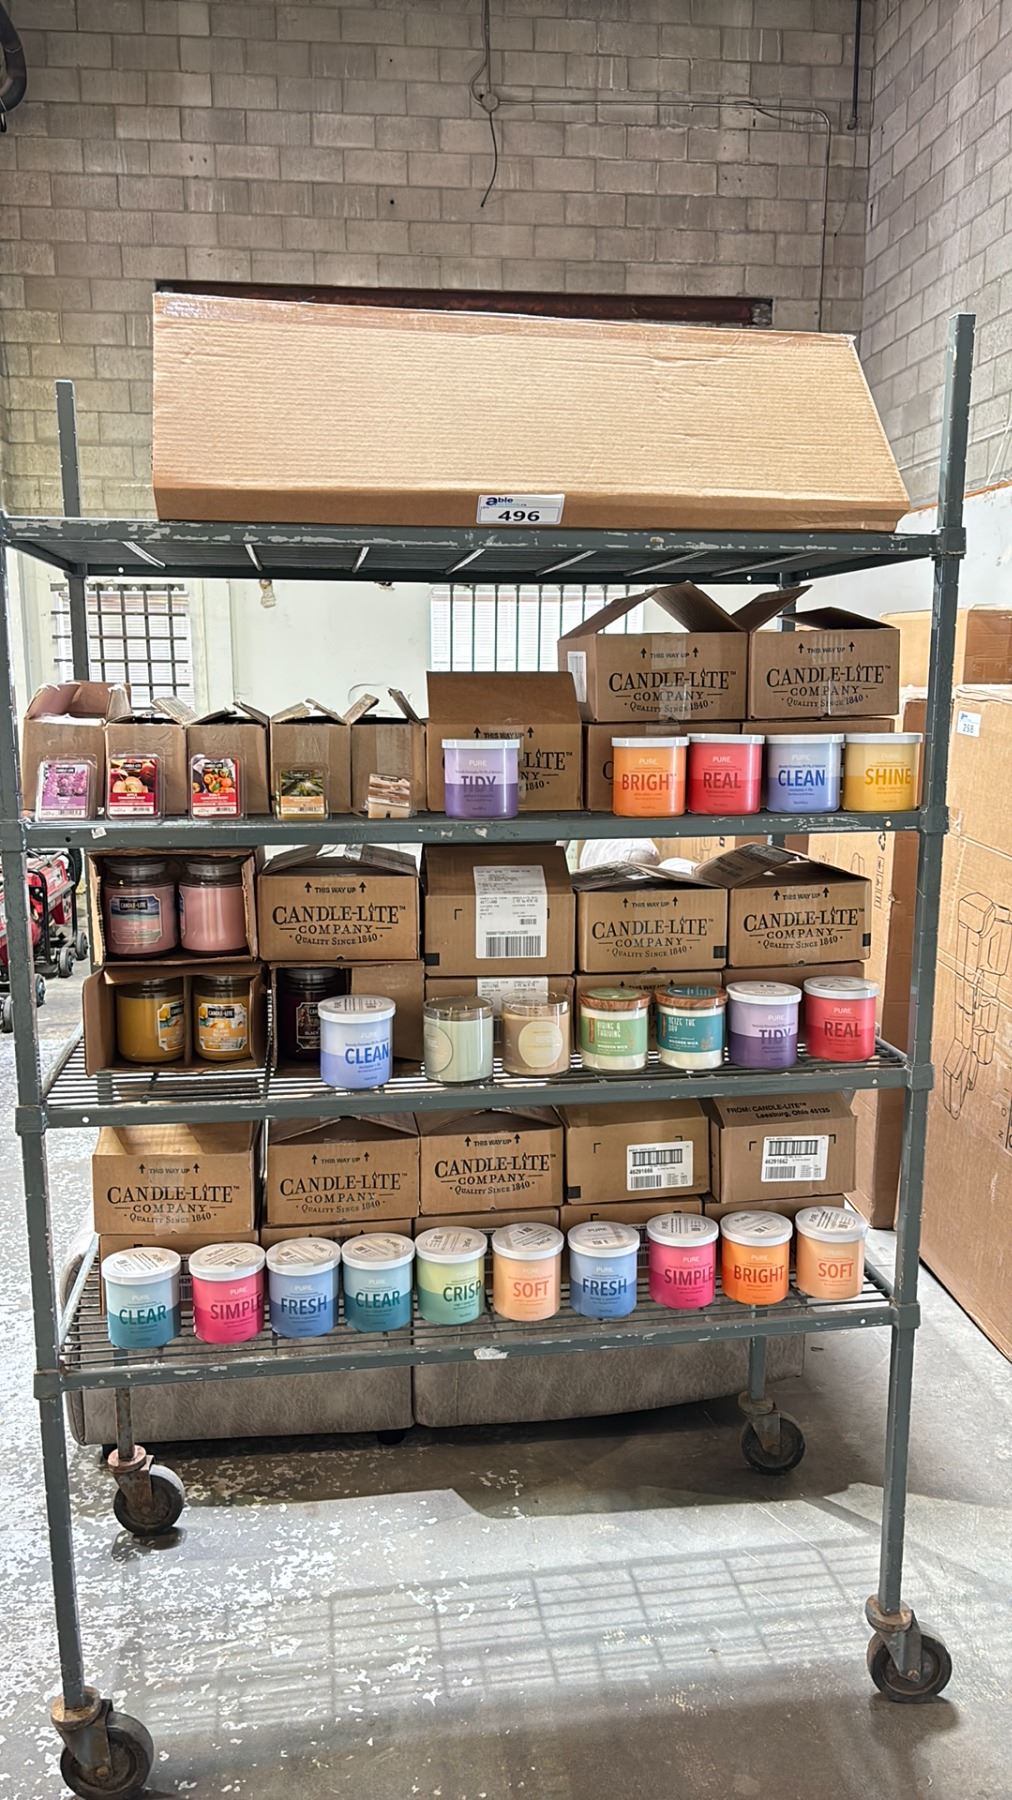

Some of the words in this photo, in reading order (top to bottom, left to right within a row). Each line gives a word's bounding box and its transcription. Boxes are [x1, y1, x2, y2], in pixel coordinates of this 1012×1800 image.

[498, 510, 540, 522] 496
[633, 691, 704, 702] COMPANY
[846, 695, 864, 704] 1840
[690, 700, 708, 710] 1840
[704, 772, 741, 789] REAL
[778, 770, 826, 786] CLEAN
[864, 768, 911, 785] SHINE
[461, 776, 496, 792] TIDY
[526, 780, 544, 792] 1840
[298, 924, 373, 935] COMPANY
[766, 928, 834, 939] COMPANY
[332, 937, 356, 946] SINCE
[358, 934, 378, 944] 1840
[615, 938, 684, 948] COMPANY
[820, 936, 838, 946] 1840
[669, 946, 687, 956] 1840
[824, 1022, 862, 1038] REAL
[758, 1028, 792, 1045] TIDY
[345, 1042, 389, 1064] CLEAN
[458, 1173, 526, 1185] COMPANY
[512, 1182, 530, 1192] 1840
[304, 1192, 376, 1203] COMPANY
[133, 1204, 207, 1213] COMPANY
[362, 1200, 380, 1210] 1840
[192, 1212, 212, 1222] 1840
[664, 1266, 713, 1286] SIMPLE
[734, 1265, 784, 1284] BRIGHT
[818, 1262, 854, 1278] SOFT
[230, 1287, 248, 1296] PURE
[443, 1280, 482, 1302] CRISP
[513, 1280, 550, 1298] SOFT
[582, 1278, 627, 1296] FRESH
[356, 1290, 401, 1308] CLEAR
[210, 1292, 262, 1320] SIMPLE
[281, 1296, 328, 1315] FRESH
[119, 1305, 167, 1326] CLEAR
